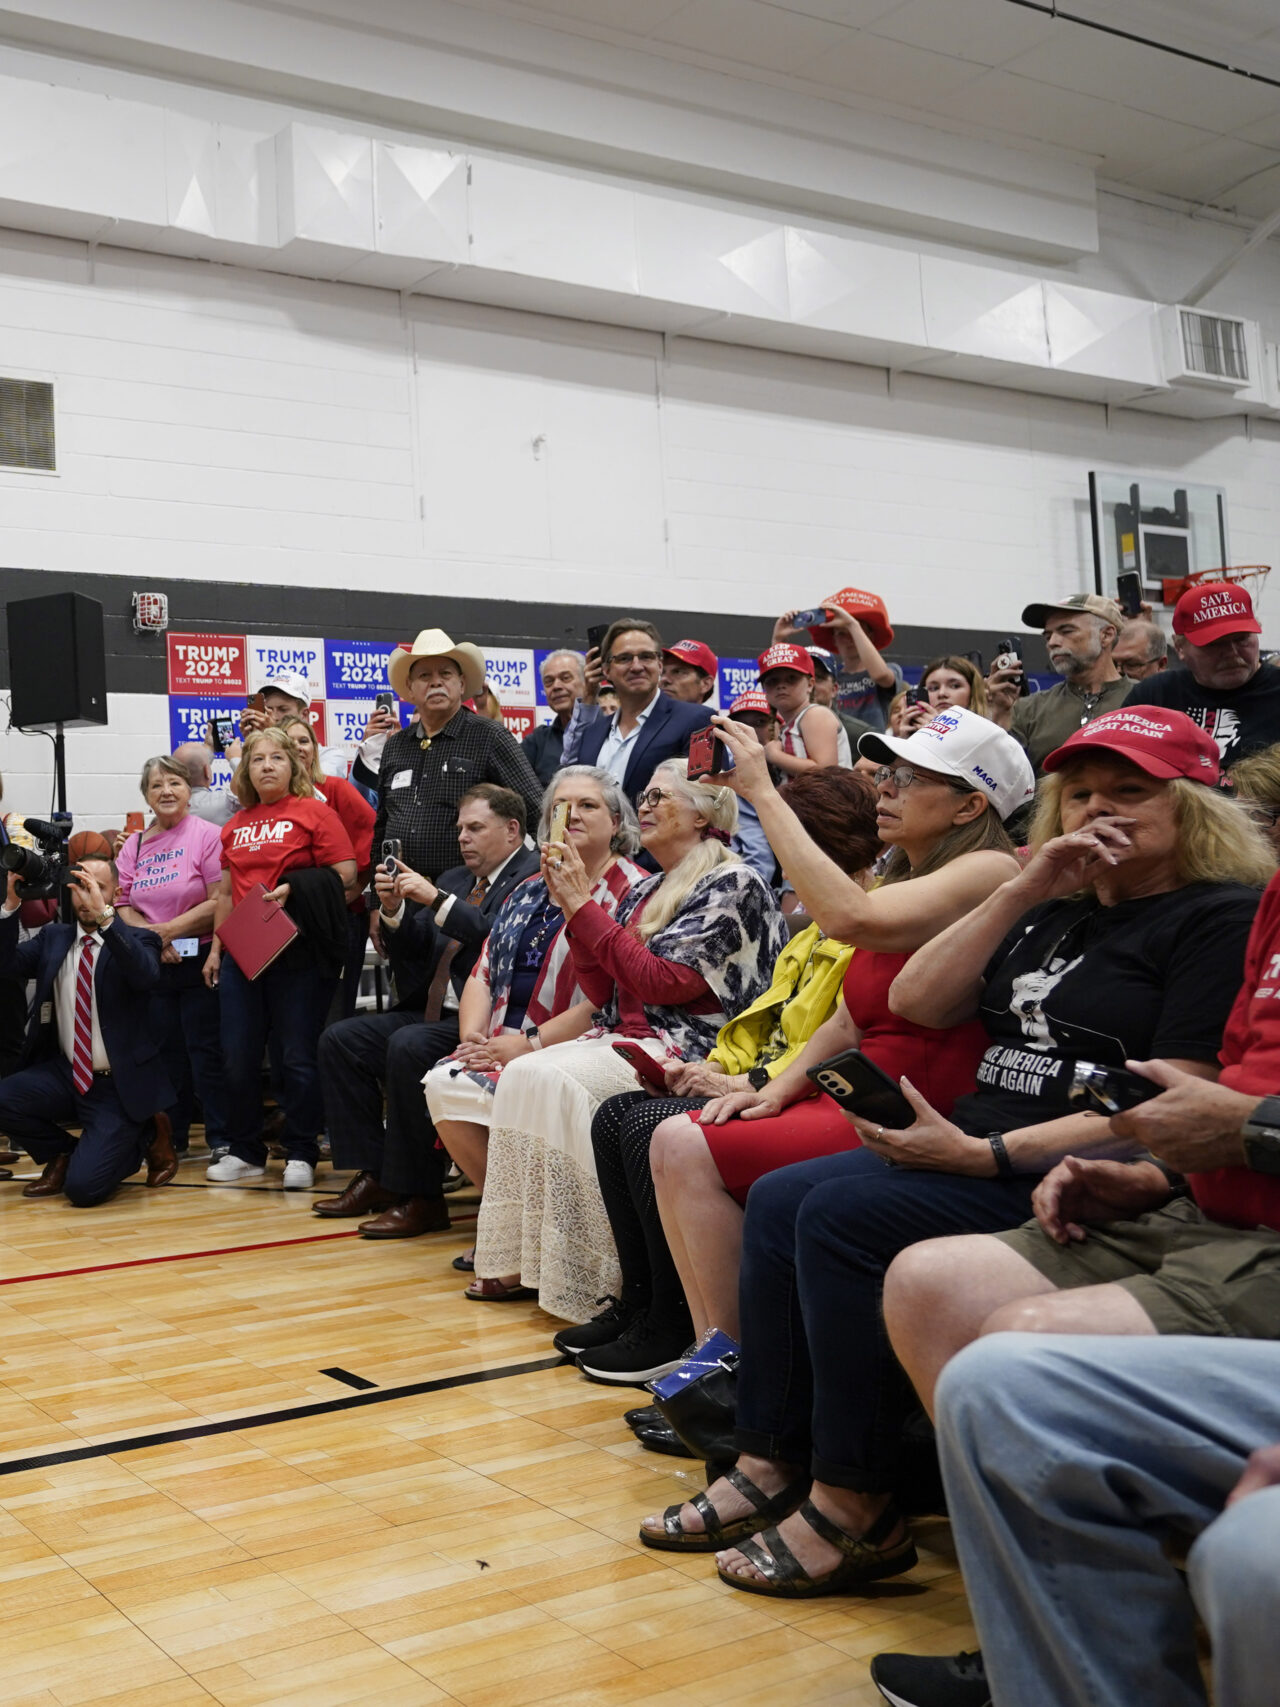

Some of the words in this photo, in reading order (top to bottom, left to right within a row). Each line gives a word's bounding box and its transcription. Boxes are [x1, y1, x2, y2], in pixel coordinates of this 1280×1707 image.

[1200, 591, 1232, 608] SAVE
[1193, 602, 1247, 624] AMERICA
[175, 645, 240, 662] TRUMP
[769, 643, 790, 653] KEEP
[256, 649, 316, 664] TRUMP
[762, 650, 799, 664] AMERICA
[766, 656, 794, 667] GREAT
[185, 661, 232, 677] 2024
[485, 660, 527, 673] RUMP
[341, 667, 383, 682] 2024
[723, 668, 760, 682] TRUM
[335, 713, 368, 726] TRU
[1113, 713, 1173, 731] AMERICA
[188, 724, 208, 739] 20
[344, 728, 364, 741] 20
[1082, 722, 1120, 736] GREAT
[1120, 723, 1164, 739] AGAIN
[972, 765, 998, 791] MAGA
[233, 821, 293, 846] TRUMP
[146, 866, 166, 875] for
[133, 872, 179, 890] TRUMP
[996, 1048, 1064, 1078] AMERICA
[1000, 1069, 1044, 1096] AGAIN
